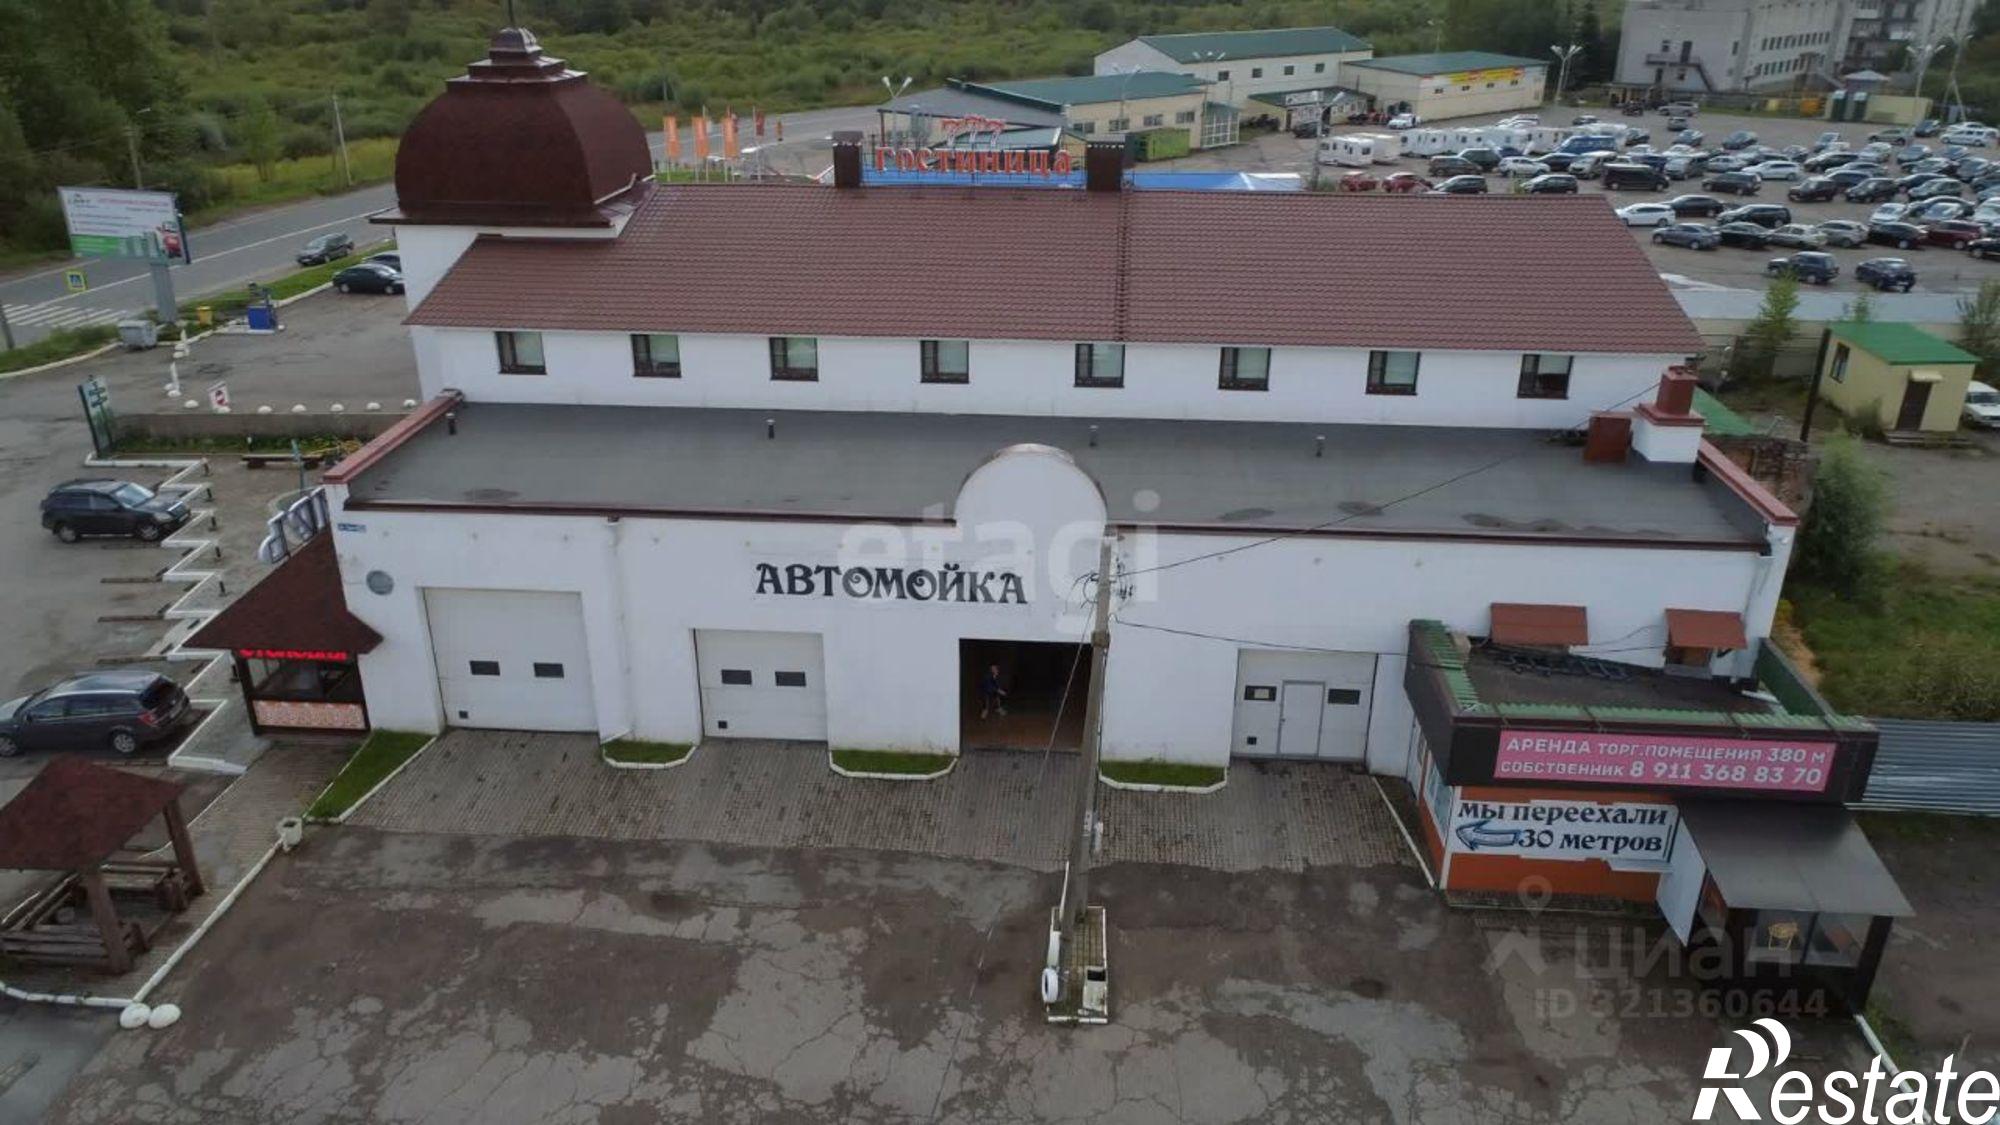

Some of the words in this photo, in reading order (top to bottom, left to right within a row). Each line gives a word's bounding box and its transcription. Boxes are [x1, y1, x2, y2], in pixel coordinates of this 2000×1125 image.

[756, 563, 1028, 604] АВТОМОЙКА
[1506, 738, 1591, 755] АРЕНДА
[1767, 748, 1807, 763] 380
[1501, 761, 1624, 777] СОБСТВЕННИК
[1629, 760, 1645, 778] 8
[1652, 762, 1692, 780] 911
[1700, 764, 1748, 783] 368
[1753, 766, 1785, 784] 83
[1791, 768, 1823, 786] 70
[1511, 804, 1669, 826] переехали
[1518, 829, 1554, 848] 30
[1559, 833, 1663, 855] метров
